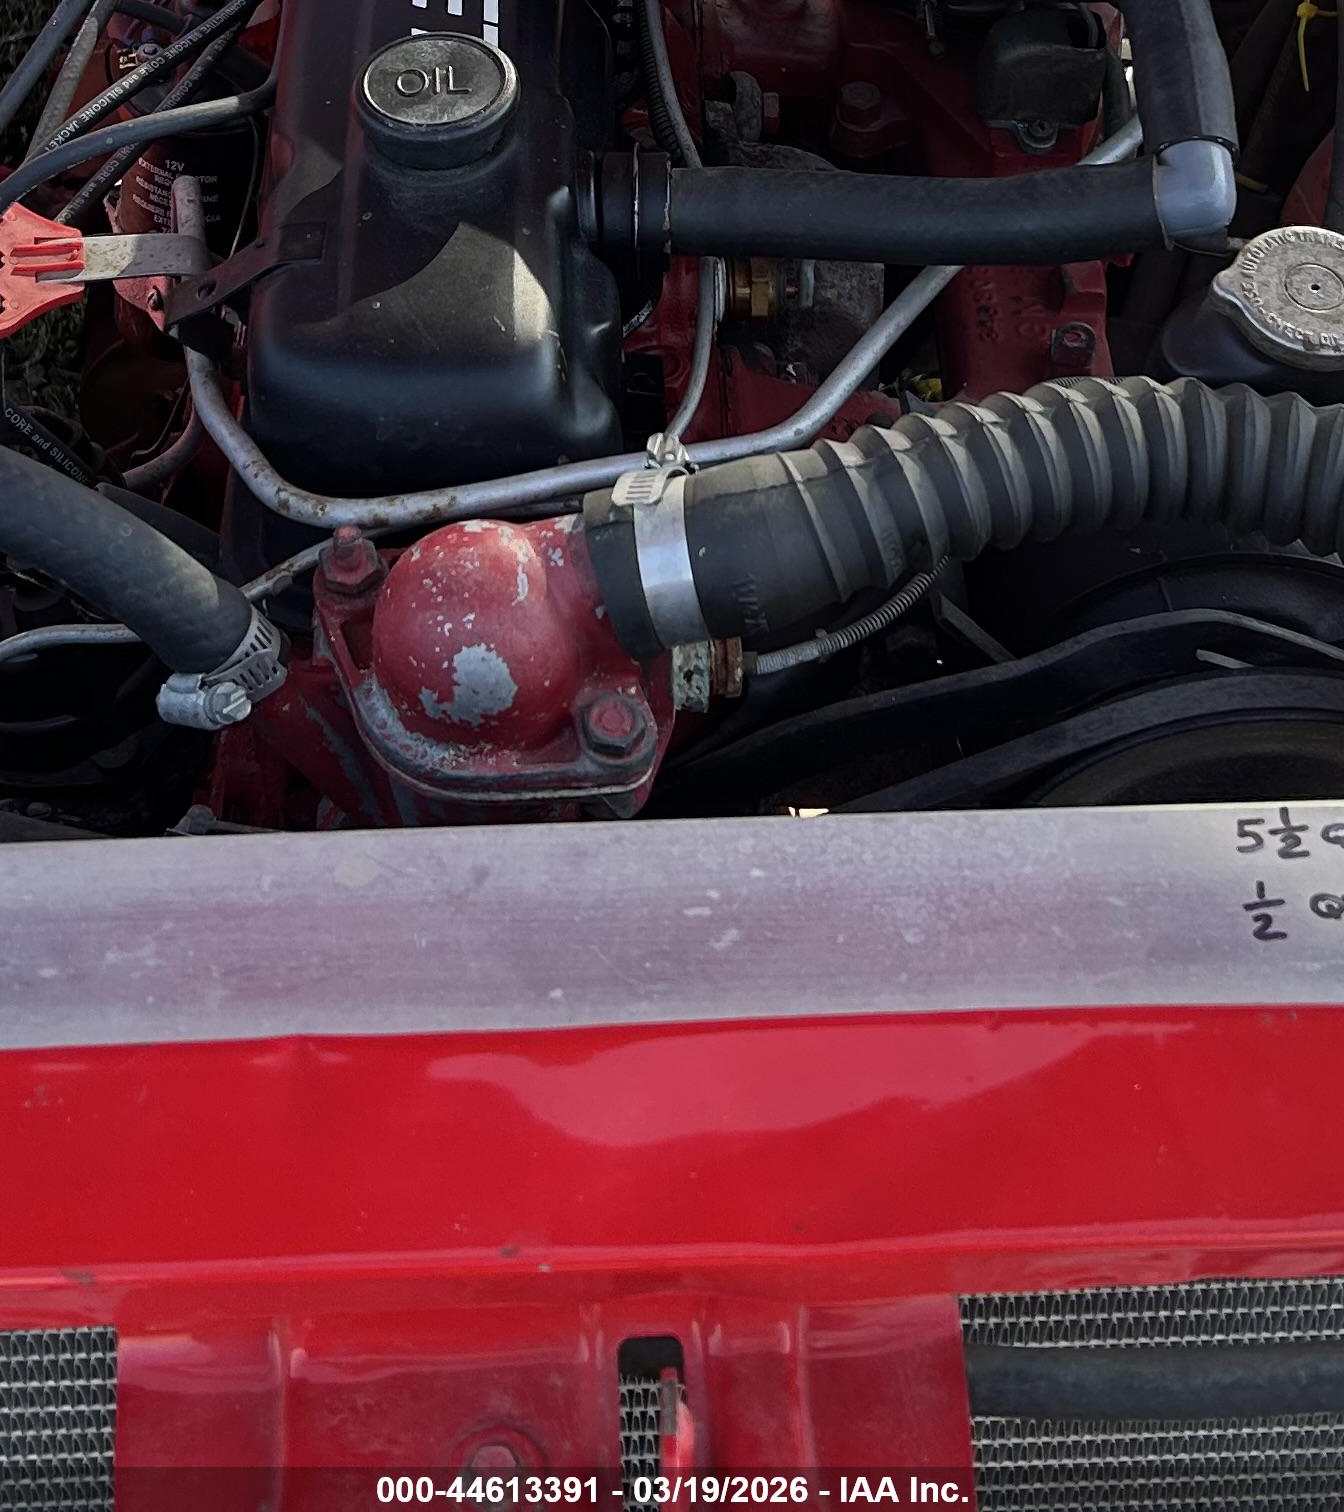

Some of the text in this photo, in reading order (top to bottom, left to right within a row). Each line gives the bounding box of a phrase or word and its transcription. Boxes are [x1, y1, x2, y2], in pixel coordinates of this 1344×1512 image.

[164, 31, 203, 60] SILICONE
[139, 57, 166, 77] CORE
[395, 66, 472, 97] OIL
[122, 74, 140, 90] and
[80, 86, 125, 122] SILICONE
[164, 159, 185, 172] 12V
[5, 407, 33, 436] CORE
[31, 431, 51, 450] and
